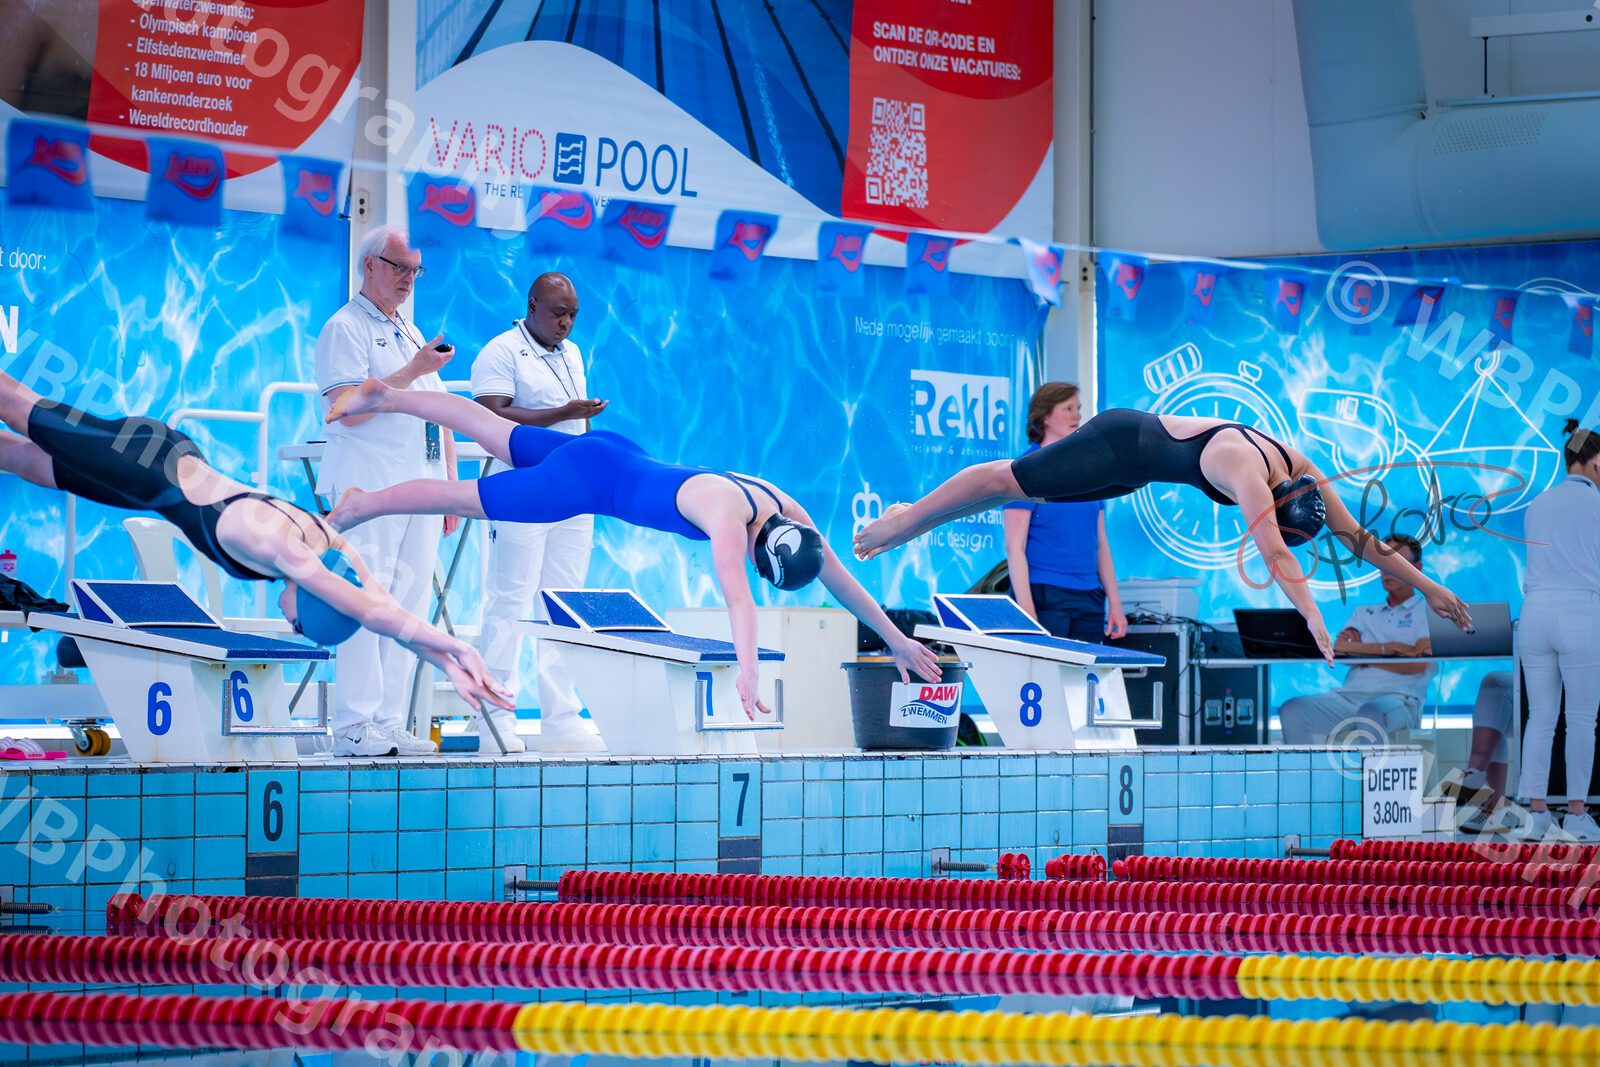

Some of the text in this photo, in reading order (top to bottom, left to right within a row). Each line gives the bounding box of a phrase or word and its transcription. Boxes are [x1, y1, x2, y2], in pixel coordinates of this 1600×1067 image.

[139, 13, 199, 36] Olympisch
[202, 21, 257, 44] kampioen
[873, 21, 995, 54] SCAN DE QR-CODE EN
[136, 37, 247, 65] Elfstedenzwemmer
[873, 45, 1021, 81] ONTDEK ONZE VACATURES:
[134, 61, 148, 78] 18
[151, 63, 194, 84] Miljoen
[197, 72, 222, 86] euro
[225, 75, 252, 90] voor
[131, 85, 232, 112] kankeronderzoek
[129, 108, 248, 137] Wereldrecordhouder
[430, 116, 698, 198] VARIO POOL
[484, 182, 506, 198] THE
[9, 246, 46, 270] door:
[887, 321, 934, 344] mogelijk
[911, 374, 1009, 441] Rekla
[947, 528, 993, 552] design
[230, 670, 254, 723] 6
[696, 671, 714, 717] 7
[919, 685, 957, 701] DAW
[1019, 682, 1042, 727] 8
[147, 681, 172, 736] 6
[900, 706, 948, 725] ZWEMMEN
[1119, 765, 1133, 815] 8
[1368, 767, 1417, 792] DIEPTE
[263, 780, 284, 842] 6
[732, 772, 750, 827] 7
[1373, 801, 1411, 825] 3.80m
